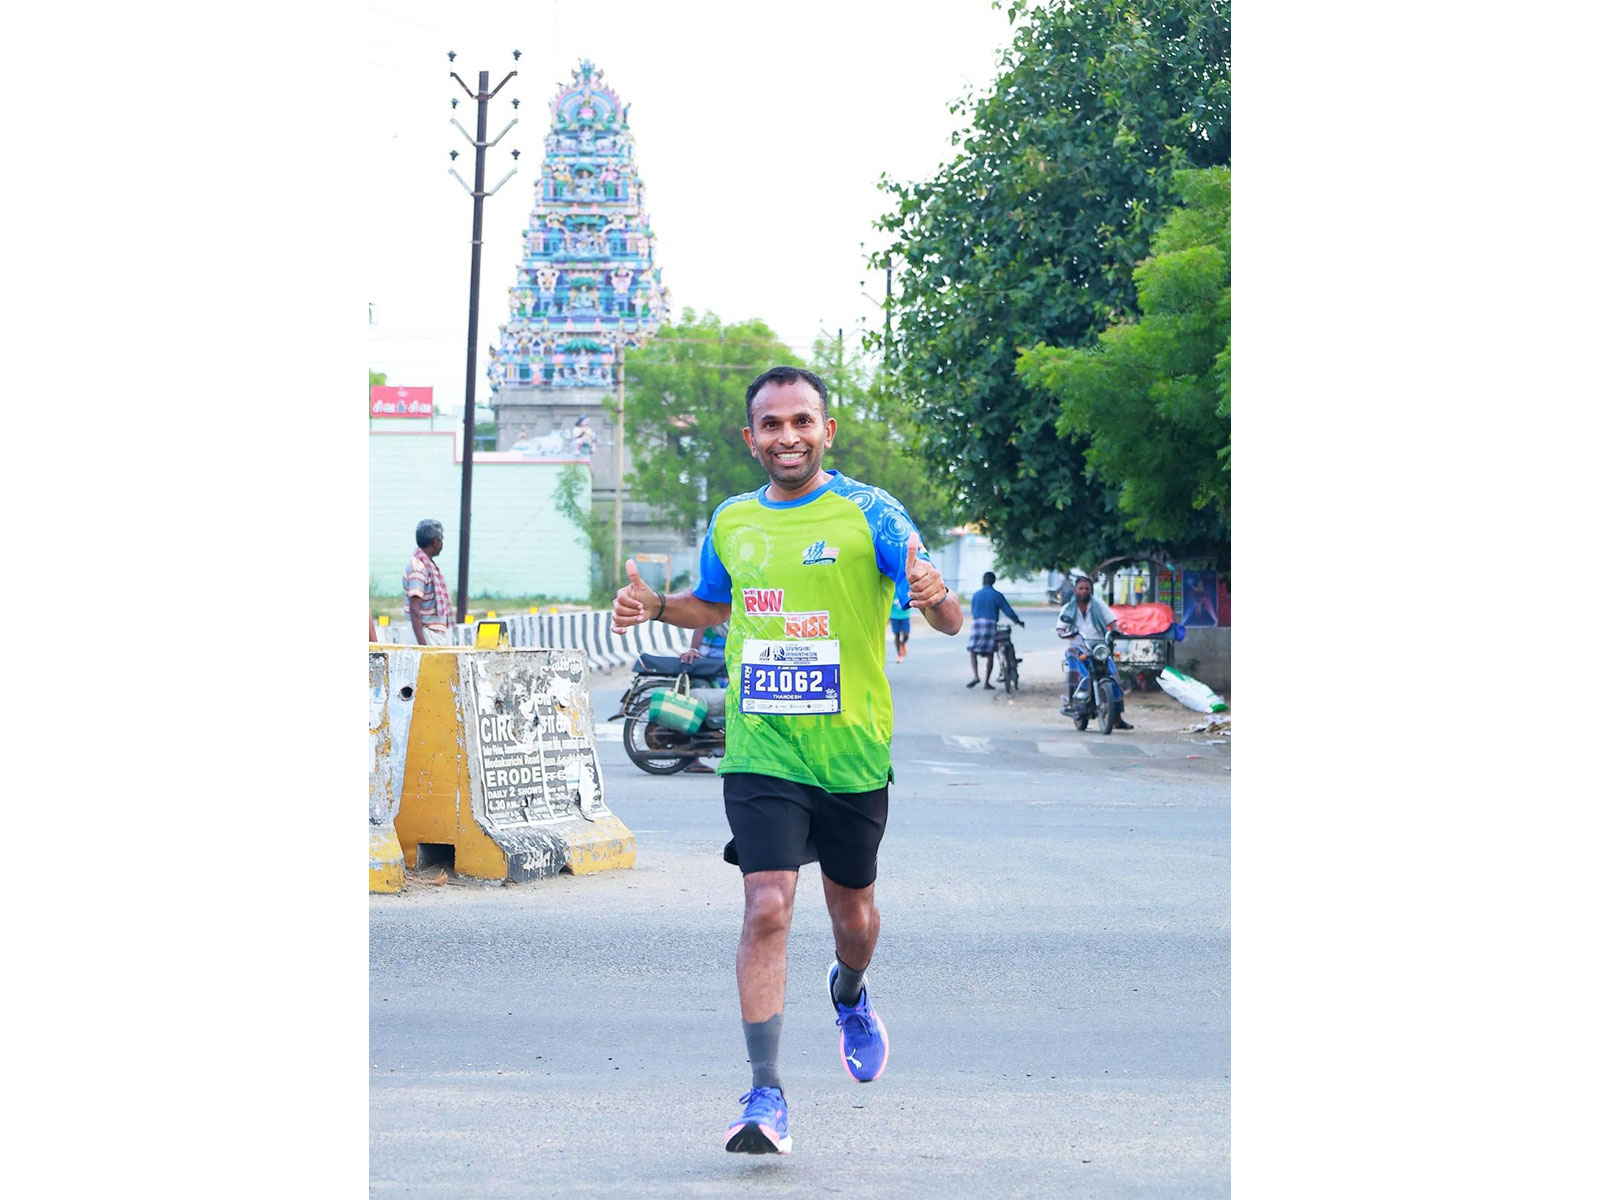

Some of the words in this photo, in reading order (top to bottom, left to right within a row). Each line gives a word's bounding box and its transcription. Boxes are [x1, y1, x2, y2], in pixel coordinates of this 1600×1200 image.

[745, 590, 783, 612] RUN
[786, 615, 829, 638] RISE
[755, 669, 824, 693] 21062
[485, 766, 543, 787] ERODE
[487, 789, 508, 800] DAILY
[509, 786, 516, 798] 2
[517, 785, 543, 796] SHOWS
